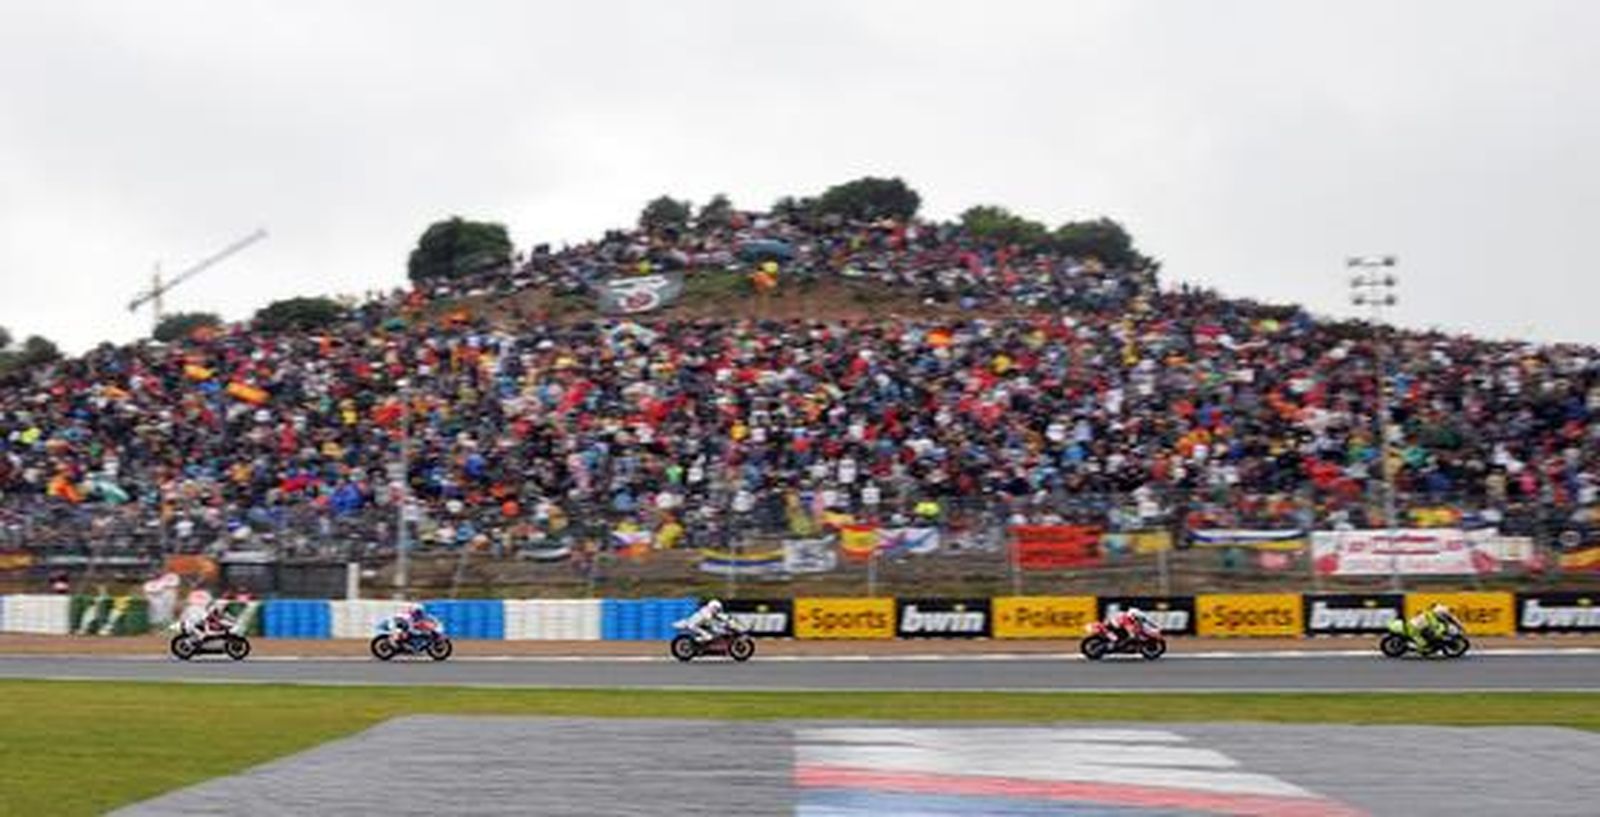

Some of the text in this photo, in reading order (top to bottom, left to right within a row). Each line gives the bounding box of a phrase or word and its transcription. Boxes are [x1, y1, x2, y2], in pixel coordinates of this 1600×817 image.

[812, 608, 888, 631] Sports
[901, 604, 985, 632] bwin
[1015, 608, 1085, 628] Poker
[1214, 606, 1292, 630] Sports
[1310, 601, 1397, 629] bwin
